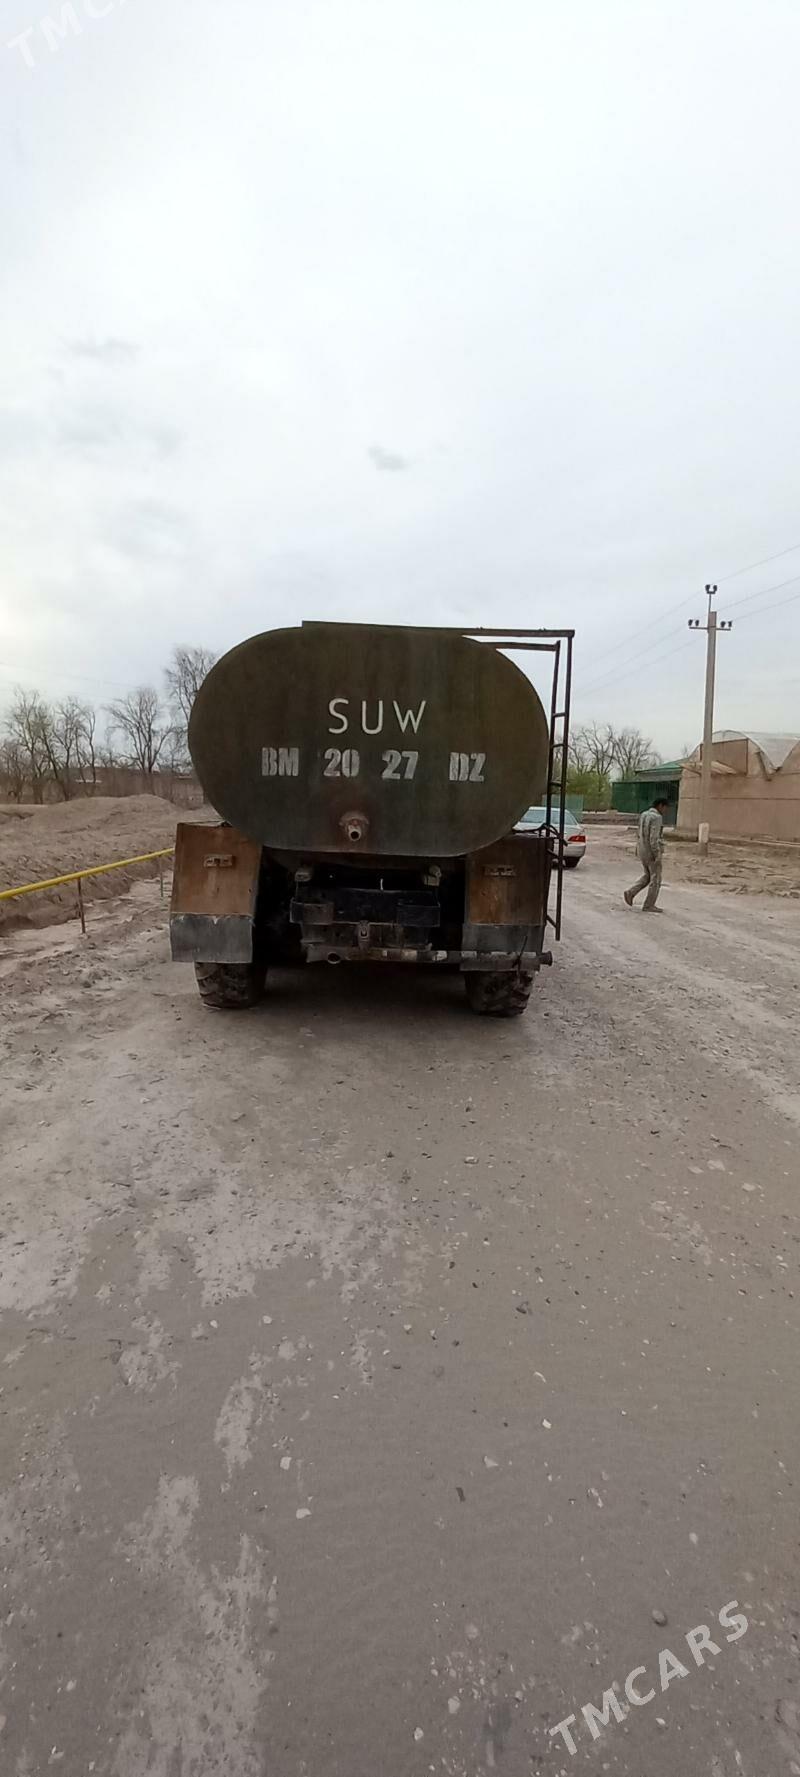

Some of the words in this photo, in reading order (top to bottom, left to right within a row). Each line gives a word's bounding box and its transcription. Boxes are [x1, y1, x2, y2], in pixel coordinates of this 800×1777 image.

[328, 698, 426, 734] SUW
[261, 747, 299, 777] BM
[323, 748, 360, 778] 20
[381, 750, 418, 780] 27
[449, 752, 486, 782] DZ
